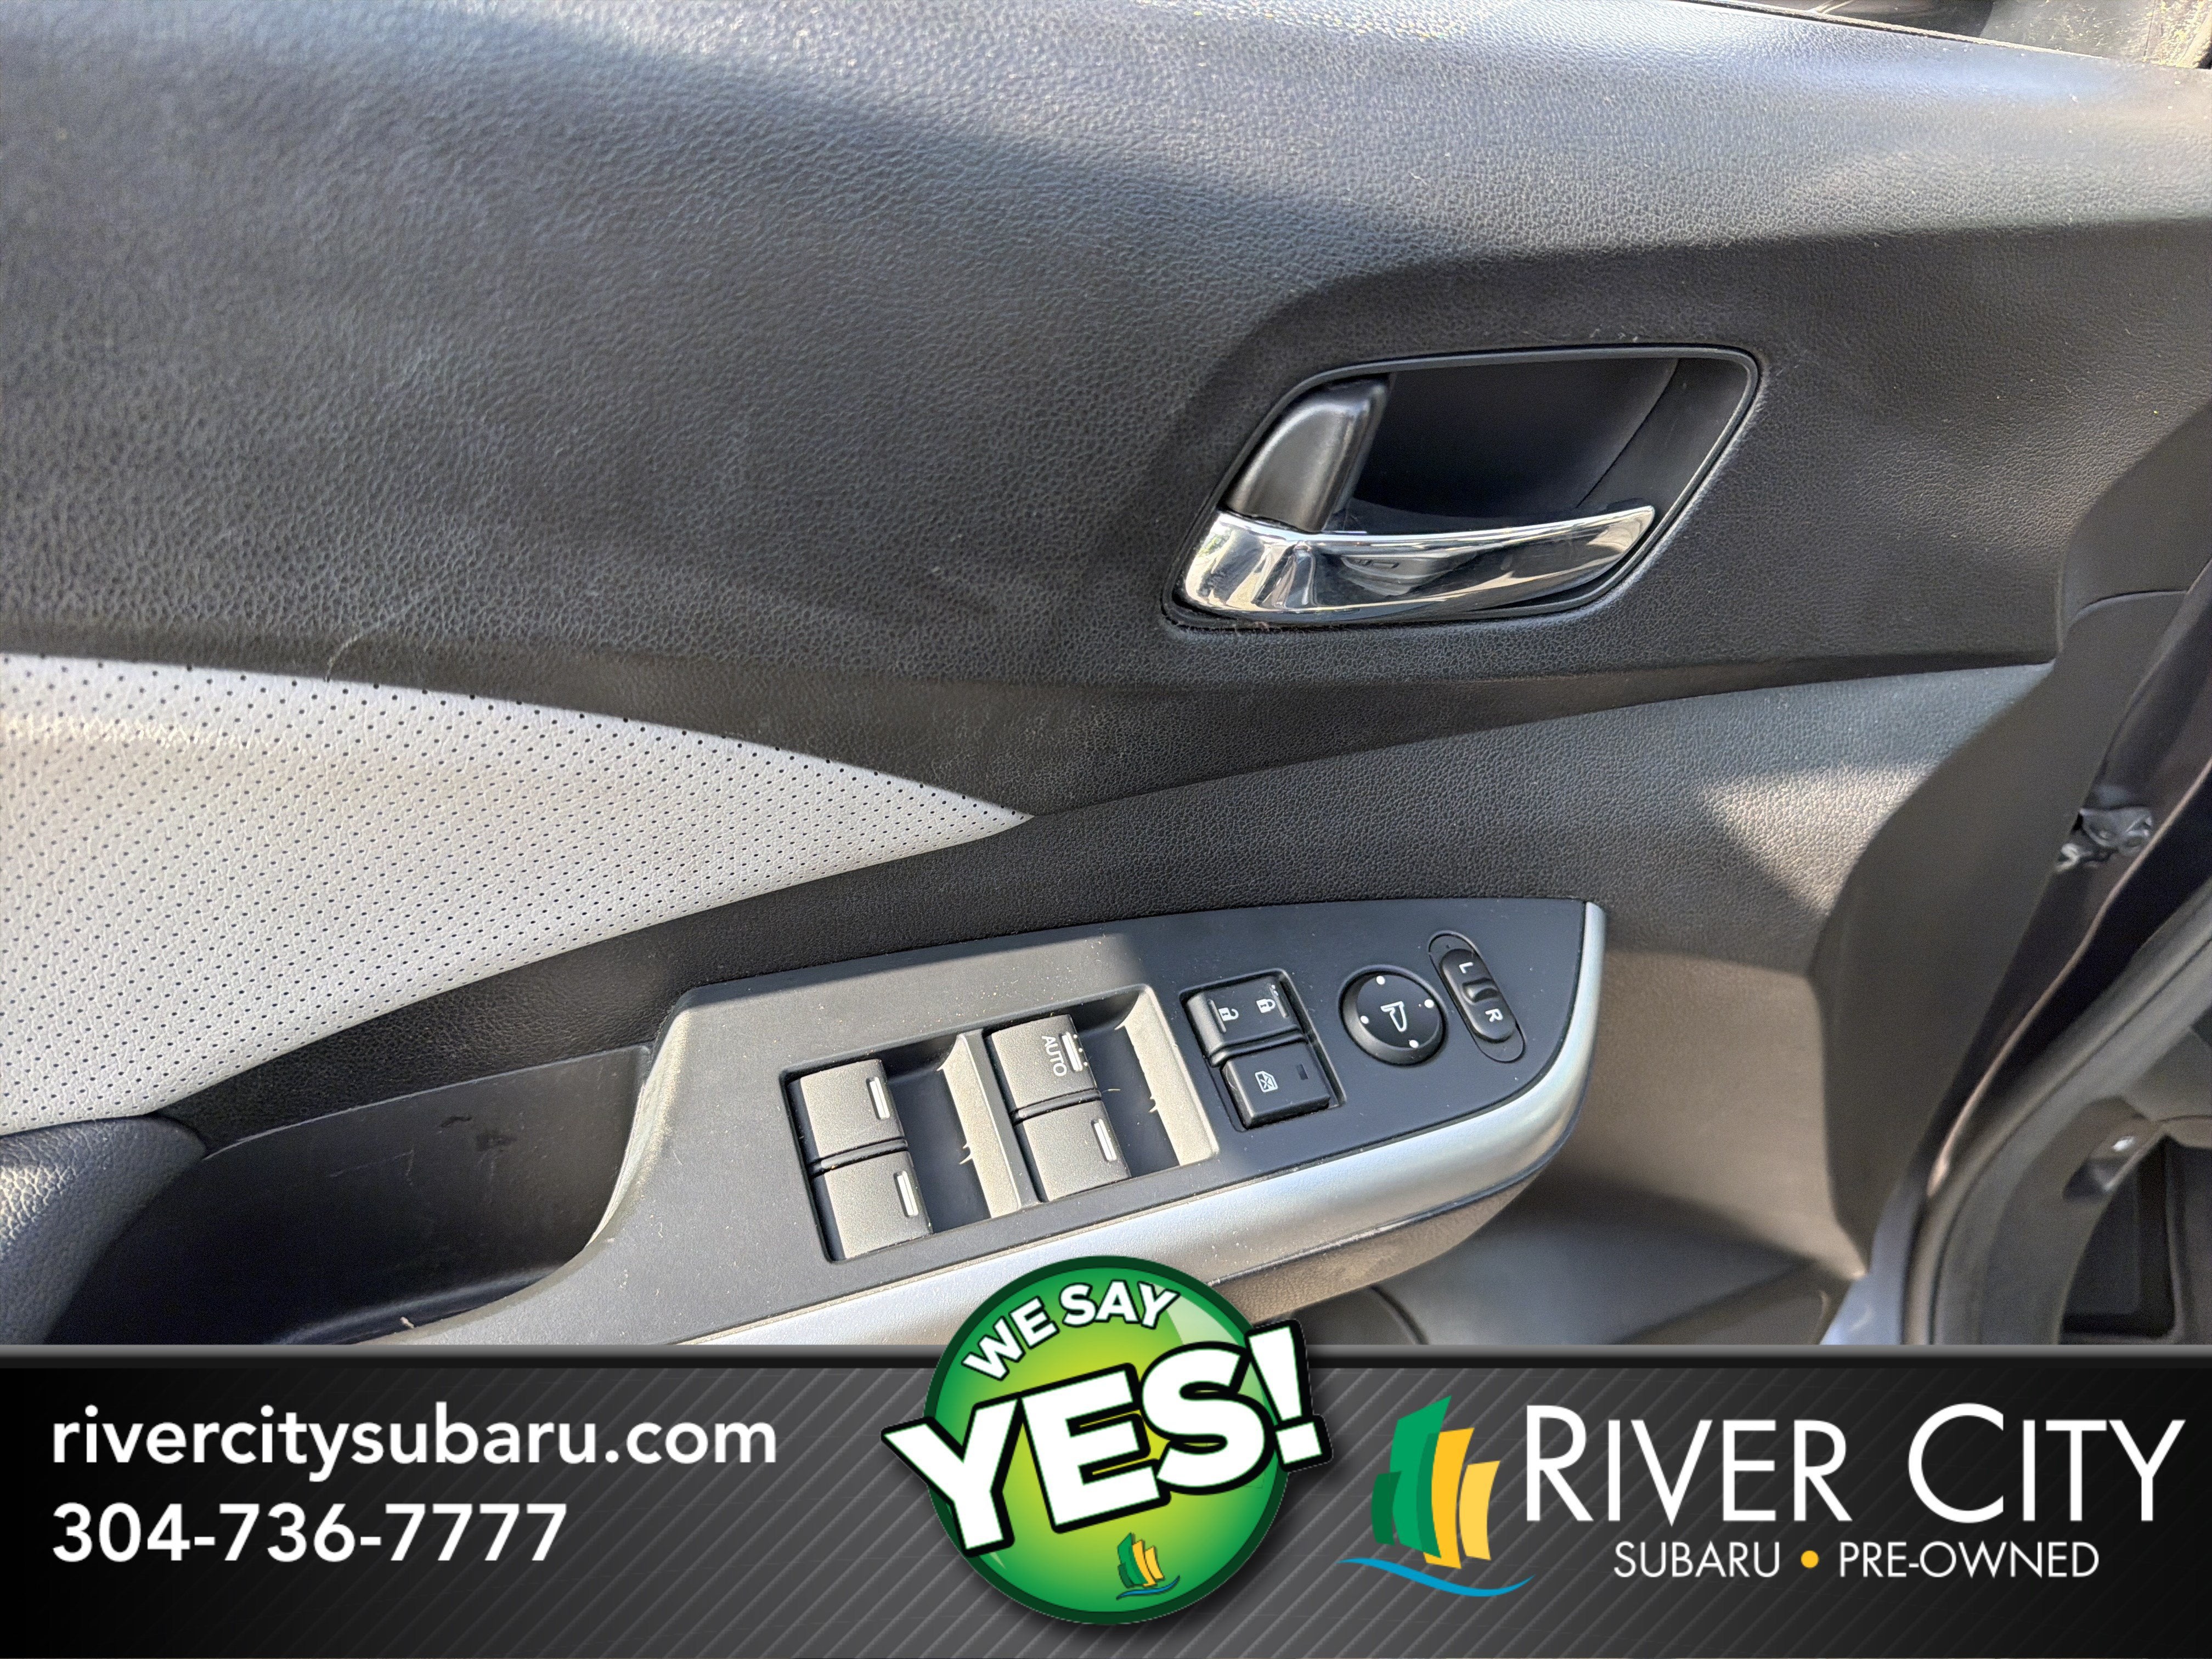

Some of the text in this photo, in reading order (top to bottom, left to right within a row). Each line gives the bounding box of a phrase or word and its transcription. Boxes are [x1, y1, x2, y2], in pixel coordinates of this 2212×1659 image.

[1459, 962, 1474, 974] L
[1485, 1008, 1504, 1022] R
[1041, 1035, 1067, 1076] AUTO
